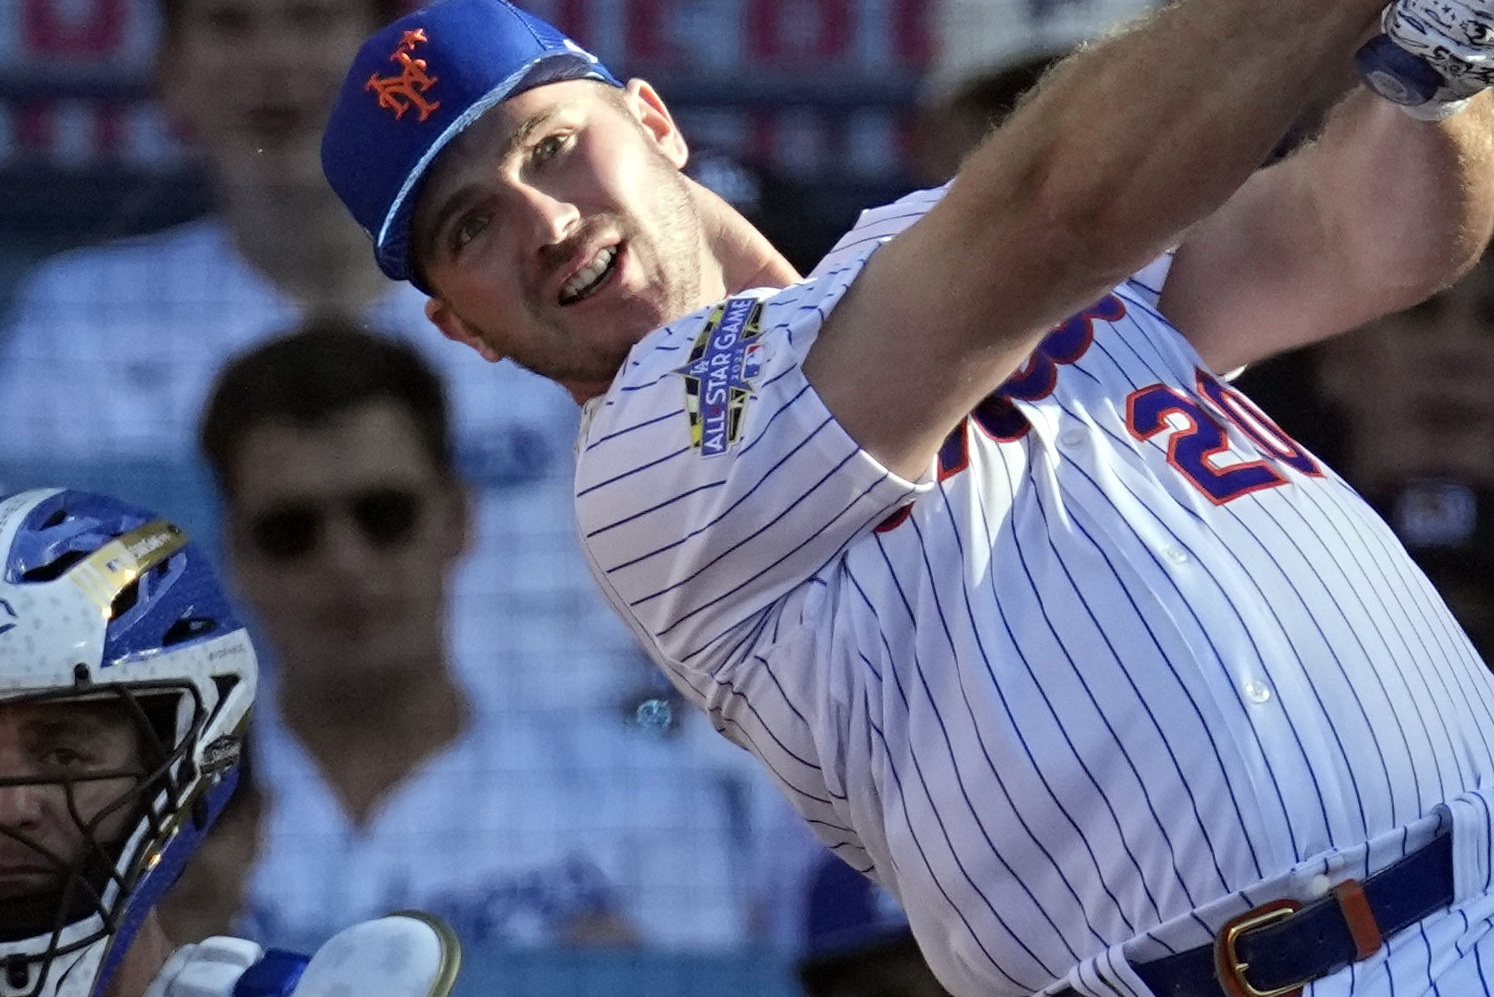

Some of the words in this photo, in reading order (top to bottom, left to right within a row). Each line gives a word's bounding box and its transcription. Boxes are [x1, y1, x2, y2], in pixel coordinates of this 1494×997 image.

[715, 300, 751, 350] GAME
[706, 352, 729, 406] STAR
[704, 410, 725, 452] ALL
[1126, 366, 1326, 506] 20
